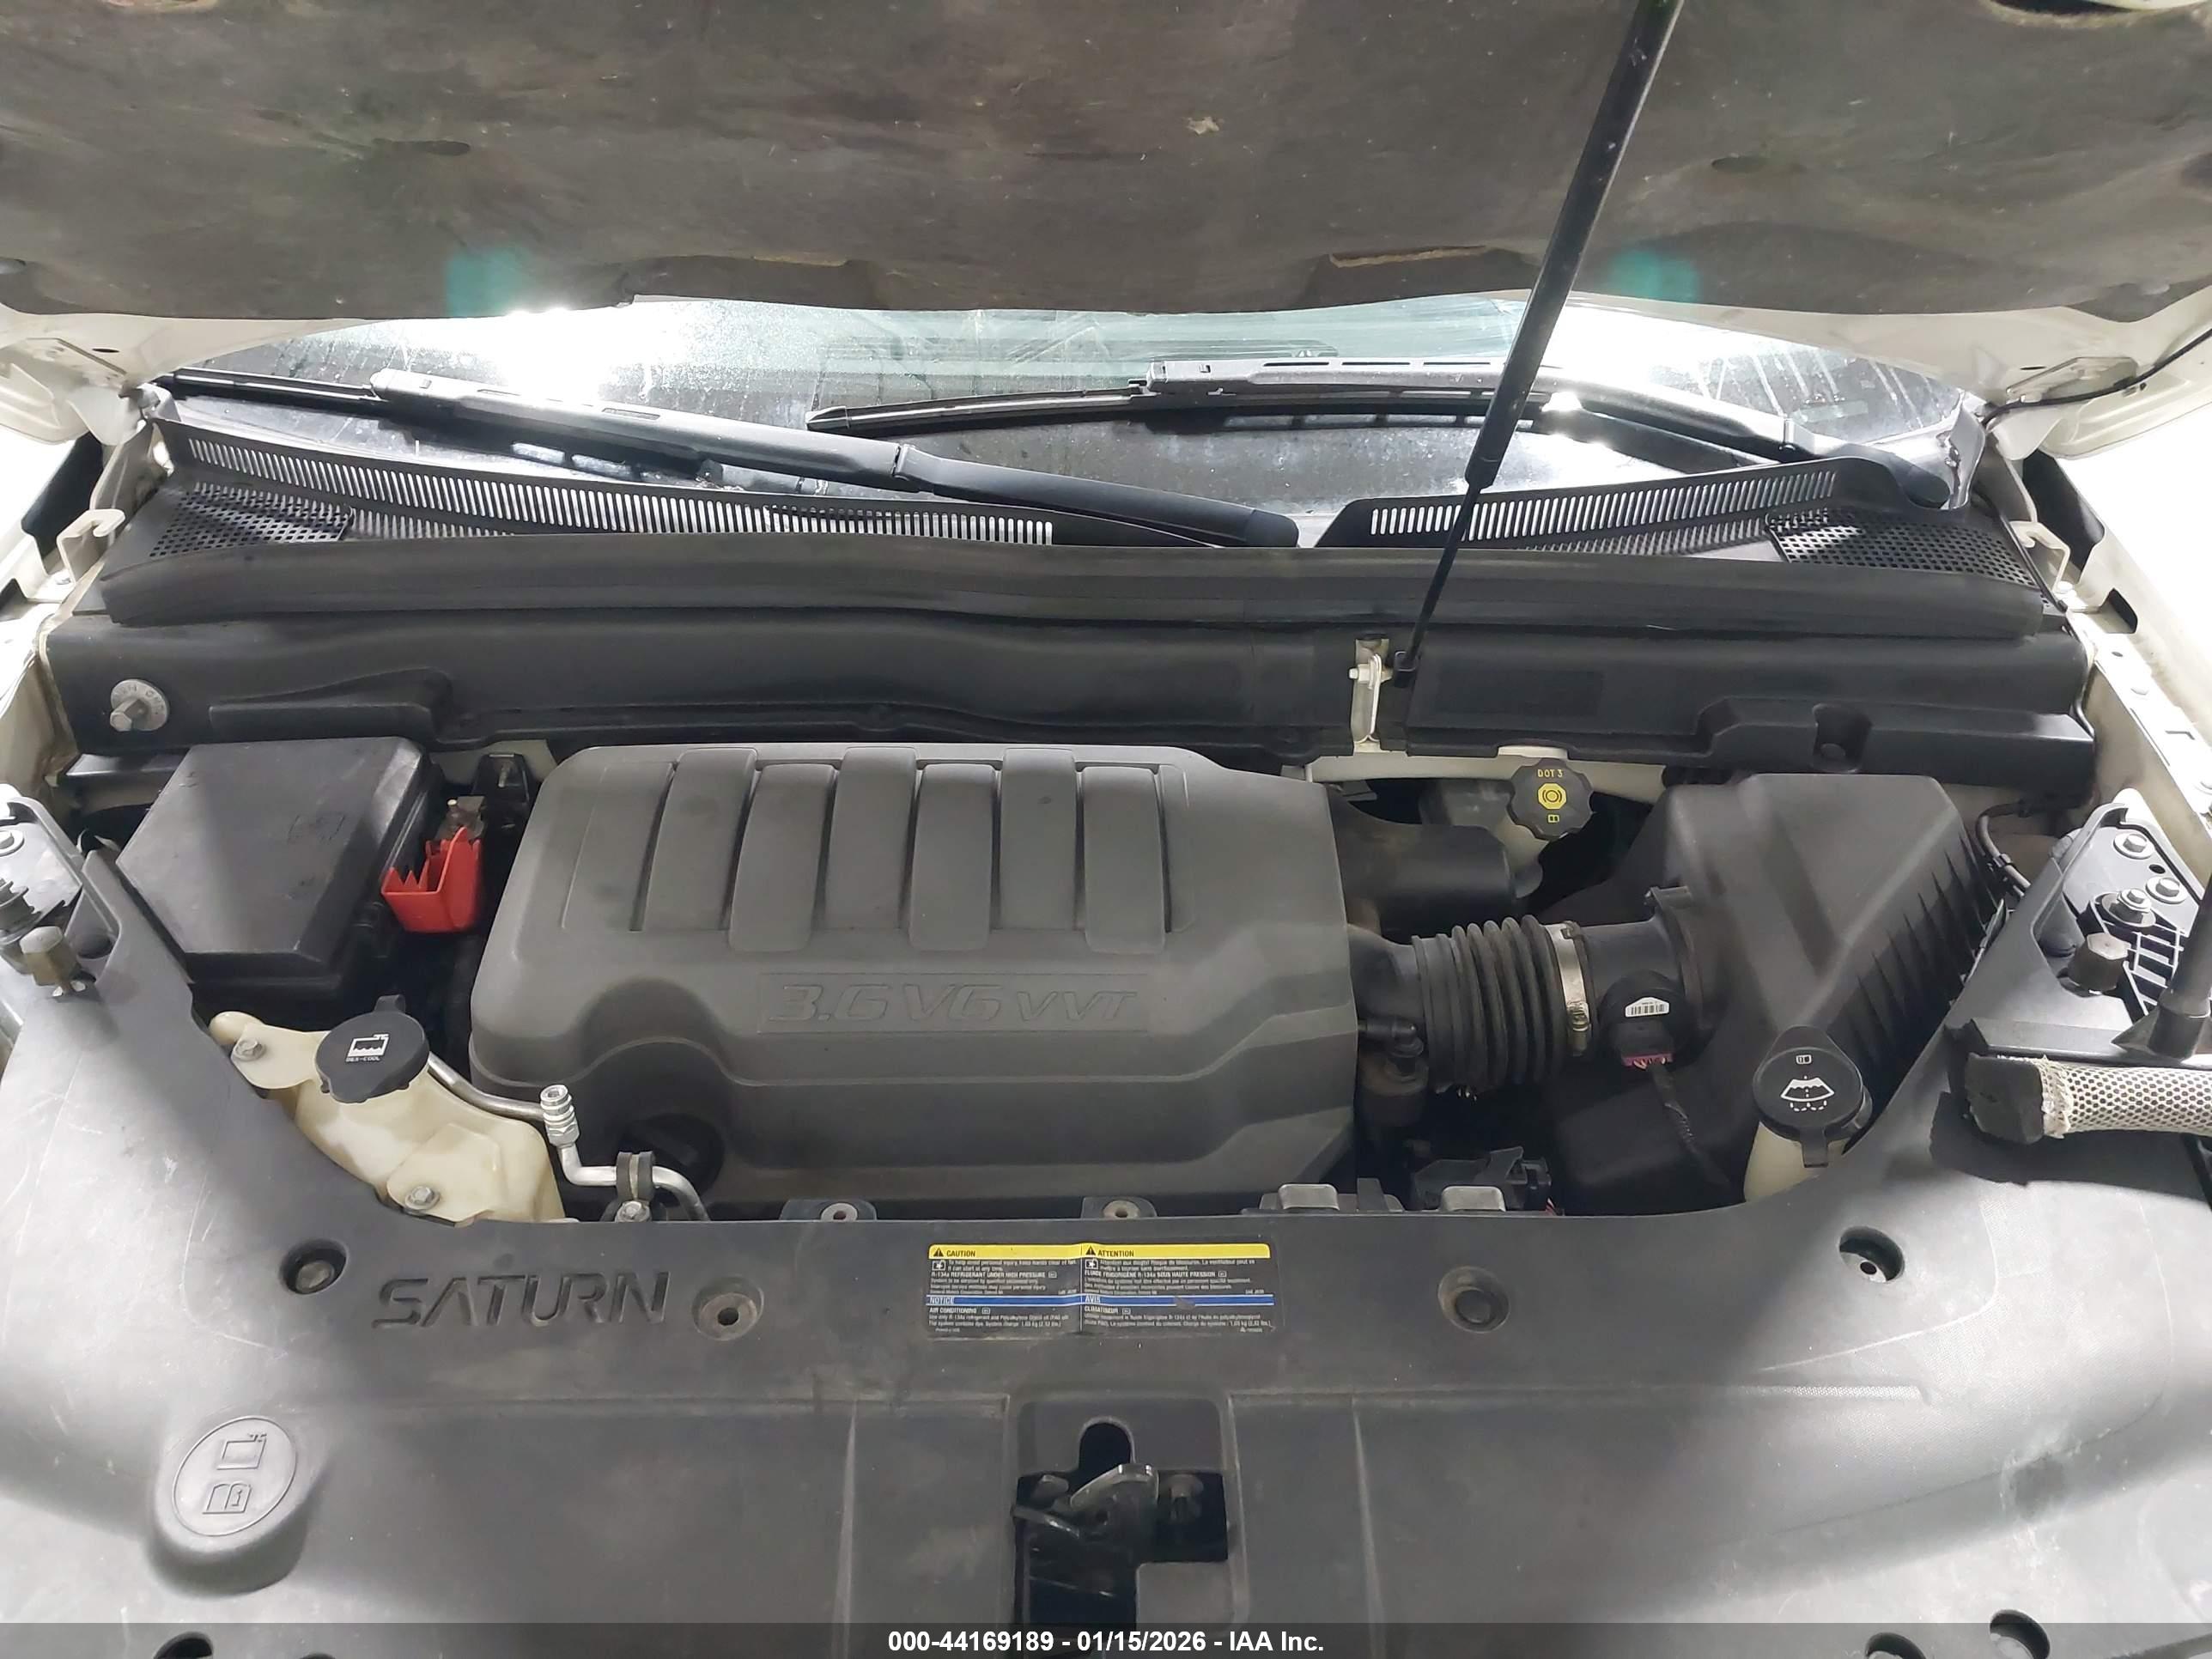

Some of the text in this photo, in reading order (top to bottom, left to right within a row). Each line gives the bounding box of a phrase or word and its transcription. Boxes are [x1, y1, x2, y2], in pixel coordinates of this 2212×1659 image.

[769, 984, 1138, 1022] 3.6 V6 VVT
[371, 1272, 672, 1328] SATURN
[1085, 1295, 1100, 1304] AVIS
